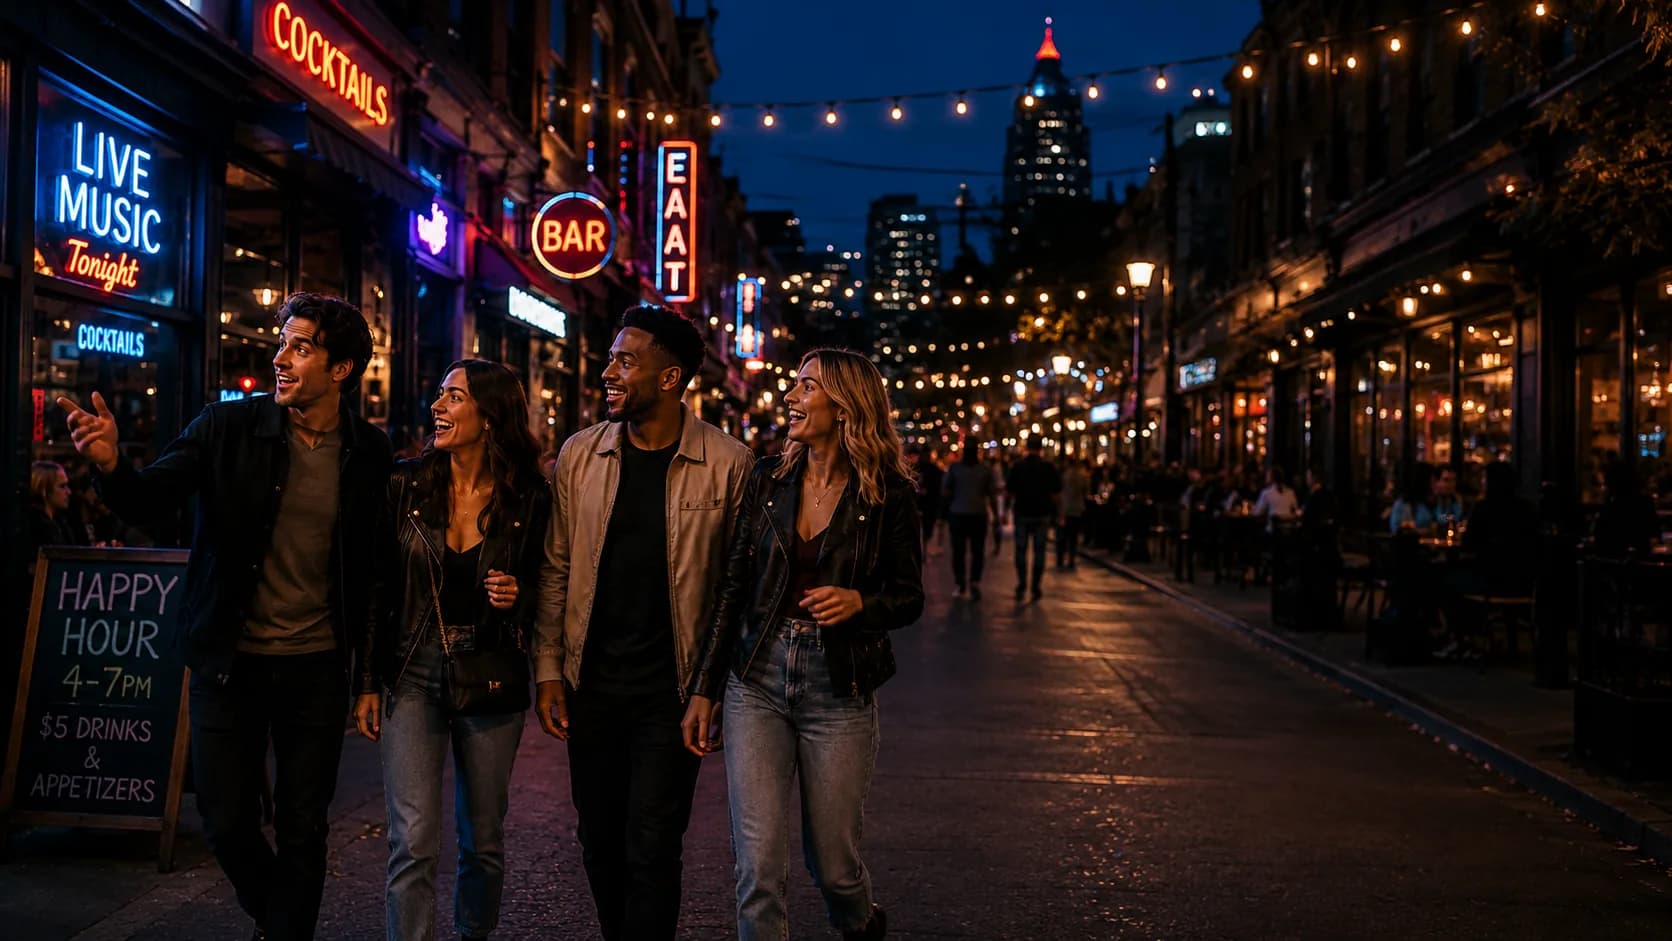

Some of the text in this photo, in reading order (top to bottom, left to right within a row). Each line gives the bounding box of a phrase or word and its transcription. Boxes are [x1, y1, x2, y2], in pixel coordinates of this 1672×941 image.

[271, 1, 389, 126] COCKTAILS
[74, 121, 151, 198] LIVE
[59, 175, 161, 255] MUSIC
[542, 220, 606, 252] BAR
[663, 153, 687, 292] EAAT
[67, 239, 139, 292] Tonight
[77, 323, 145, 358] COCKTAILS
[58, 571, 179, 614] HAPPY
[61, 617, 159, 659] HOUR
[40, 711, 152, 742] $5 DRINKS
[84, 745, 101, 770] &
[30, 773, 156, 803] APPETIZERS
